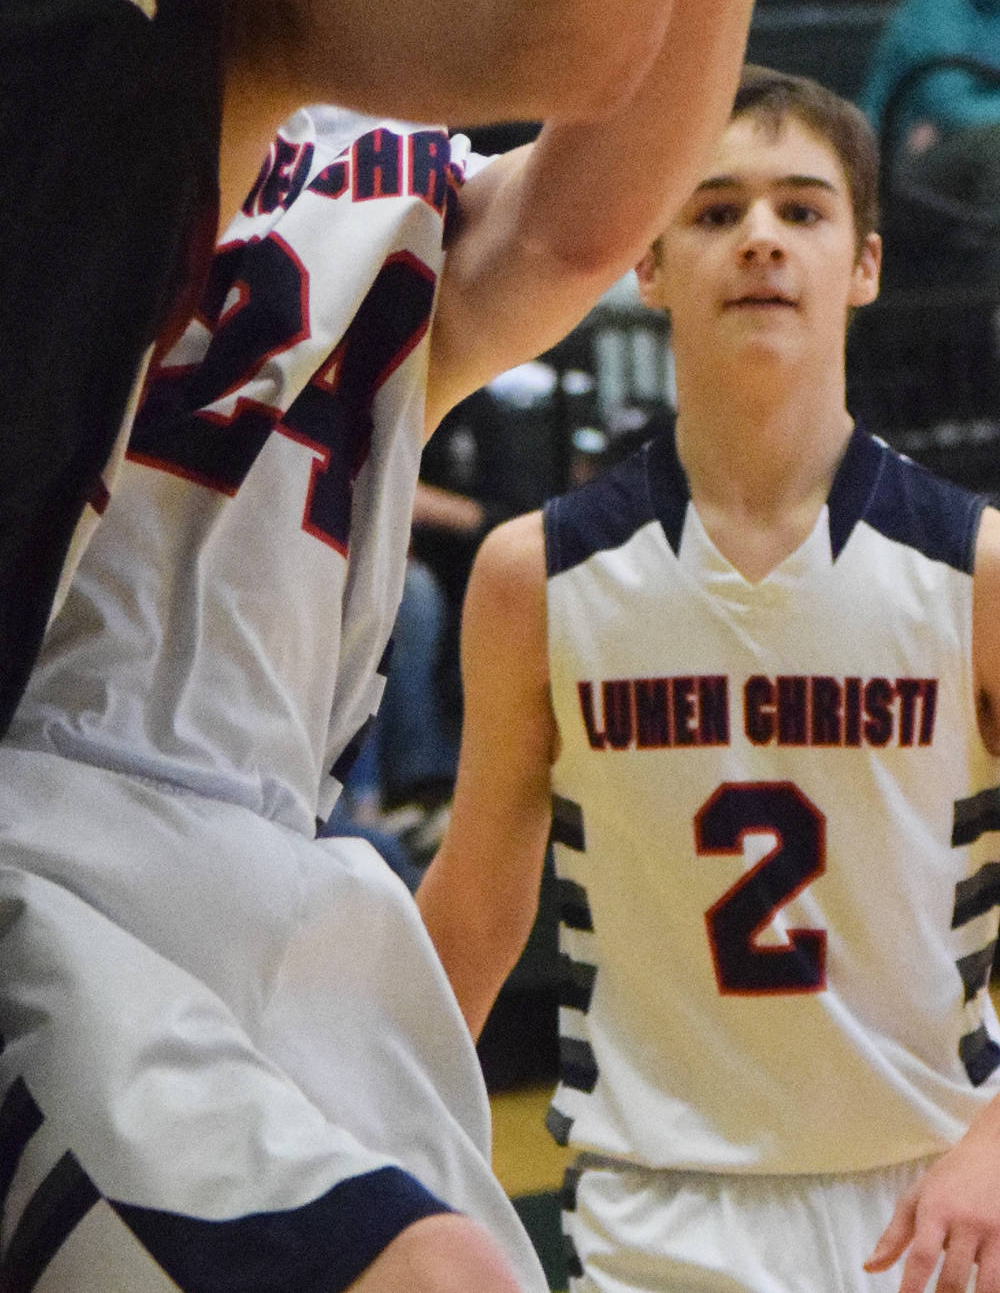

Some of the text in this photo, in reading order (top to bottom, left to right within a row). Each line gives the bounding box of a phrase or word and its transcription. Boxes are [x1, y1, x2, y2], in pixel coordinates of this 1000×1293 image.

[126, 232, 437, 558] 24
[577, 674, 939, 751] LUMEN CHRISTI
[693, 781, 828, 997] 2
